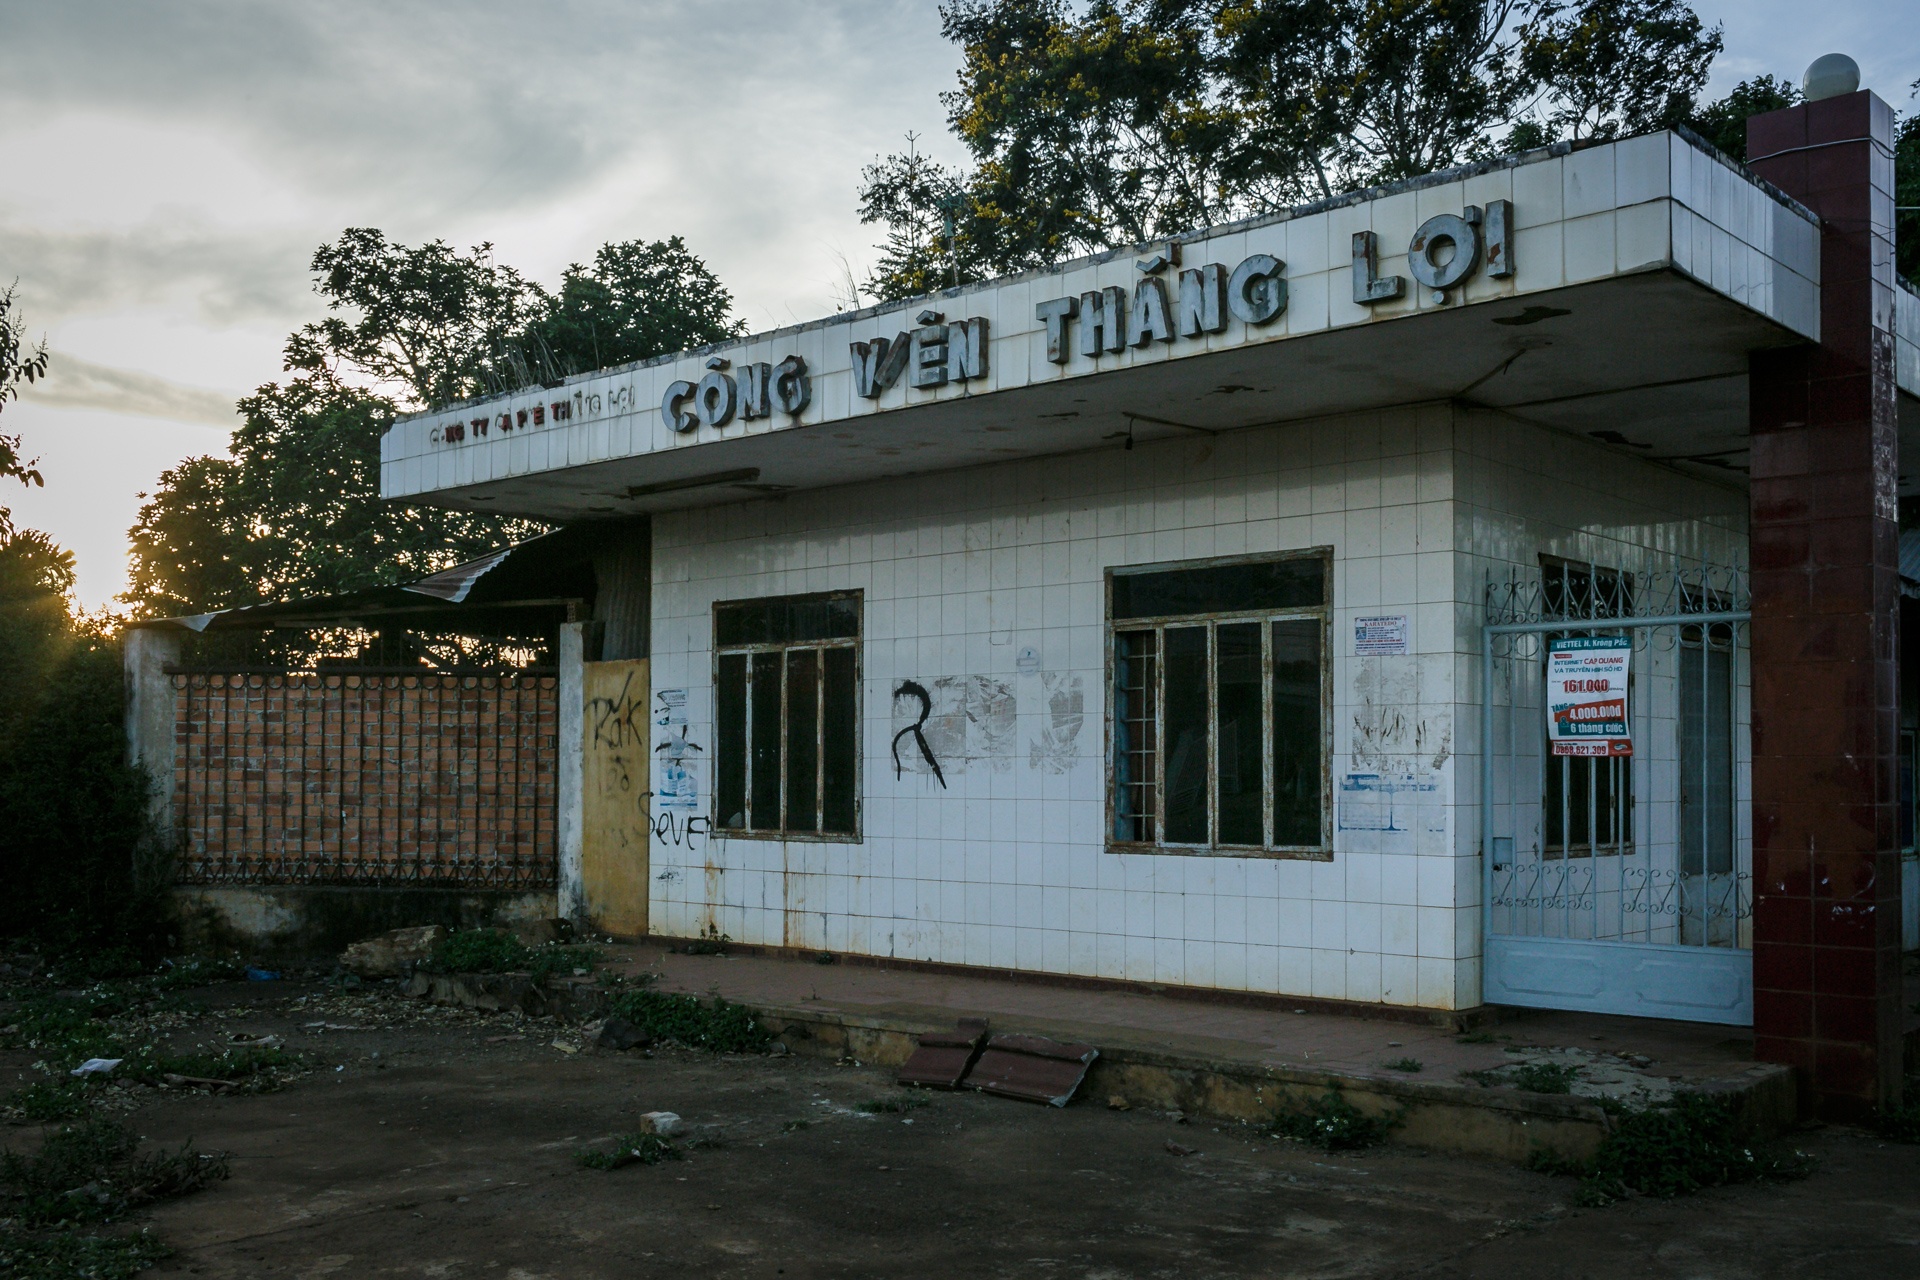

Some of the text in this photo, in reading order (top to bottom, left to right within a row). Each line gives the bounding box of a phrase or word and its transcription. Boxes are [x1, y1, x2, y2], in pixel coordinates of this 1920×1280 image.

[662, 355, 813, 433] CÔNG
[1036, 242, 1288, 365] THẮNG
[1351, 199, 1514, 306] LỢI
[470, 417, 489, 437] TY
[1556, 640, 1582, 649] VIETTEL
[1598, 656, 1624, 665] QUANG
[1570, 722, 1577, 733] 6
[1578, 721, 1603, 734] tháng
